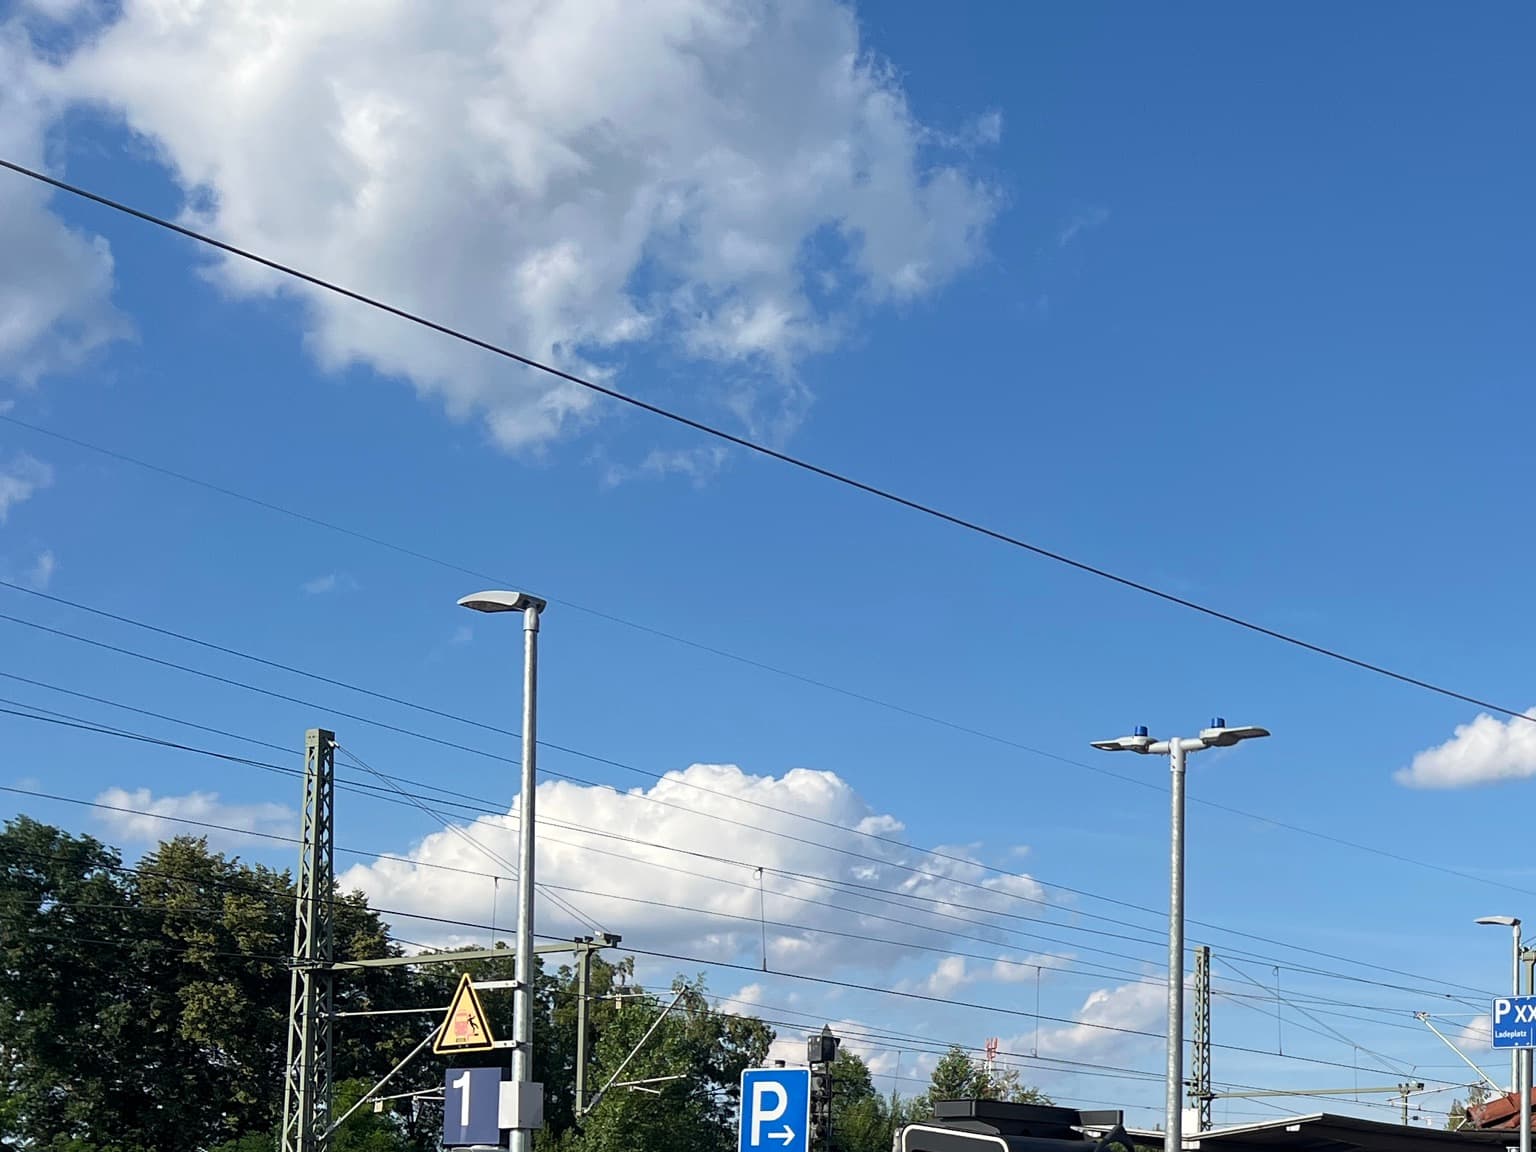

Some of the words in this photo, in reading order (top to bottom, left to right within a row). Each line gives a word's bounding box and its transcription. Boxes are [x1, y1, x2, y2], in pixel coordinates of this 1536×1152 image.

[1495, 1000, 1511, 1024] P
[1495, 1029, 1527, 1039] Ladeplatz
[453, 1071, 471, 1127] 1
[750, 1081, 788, 1146] P
